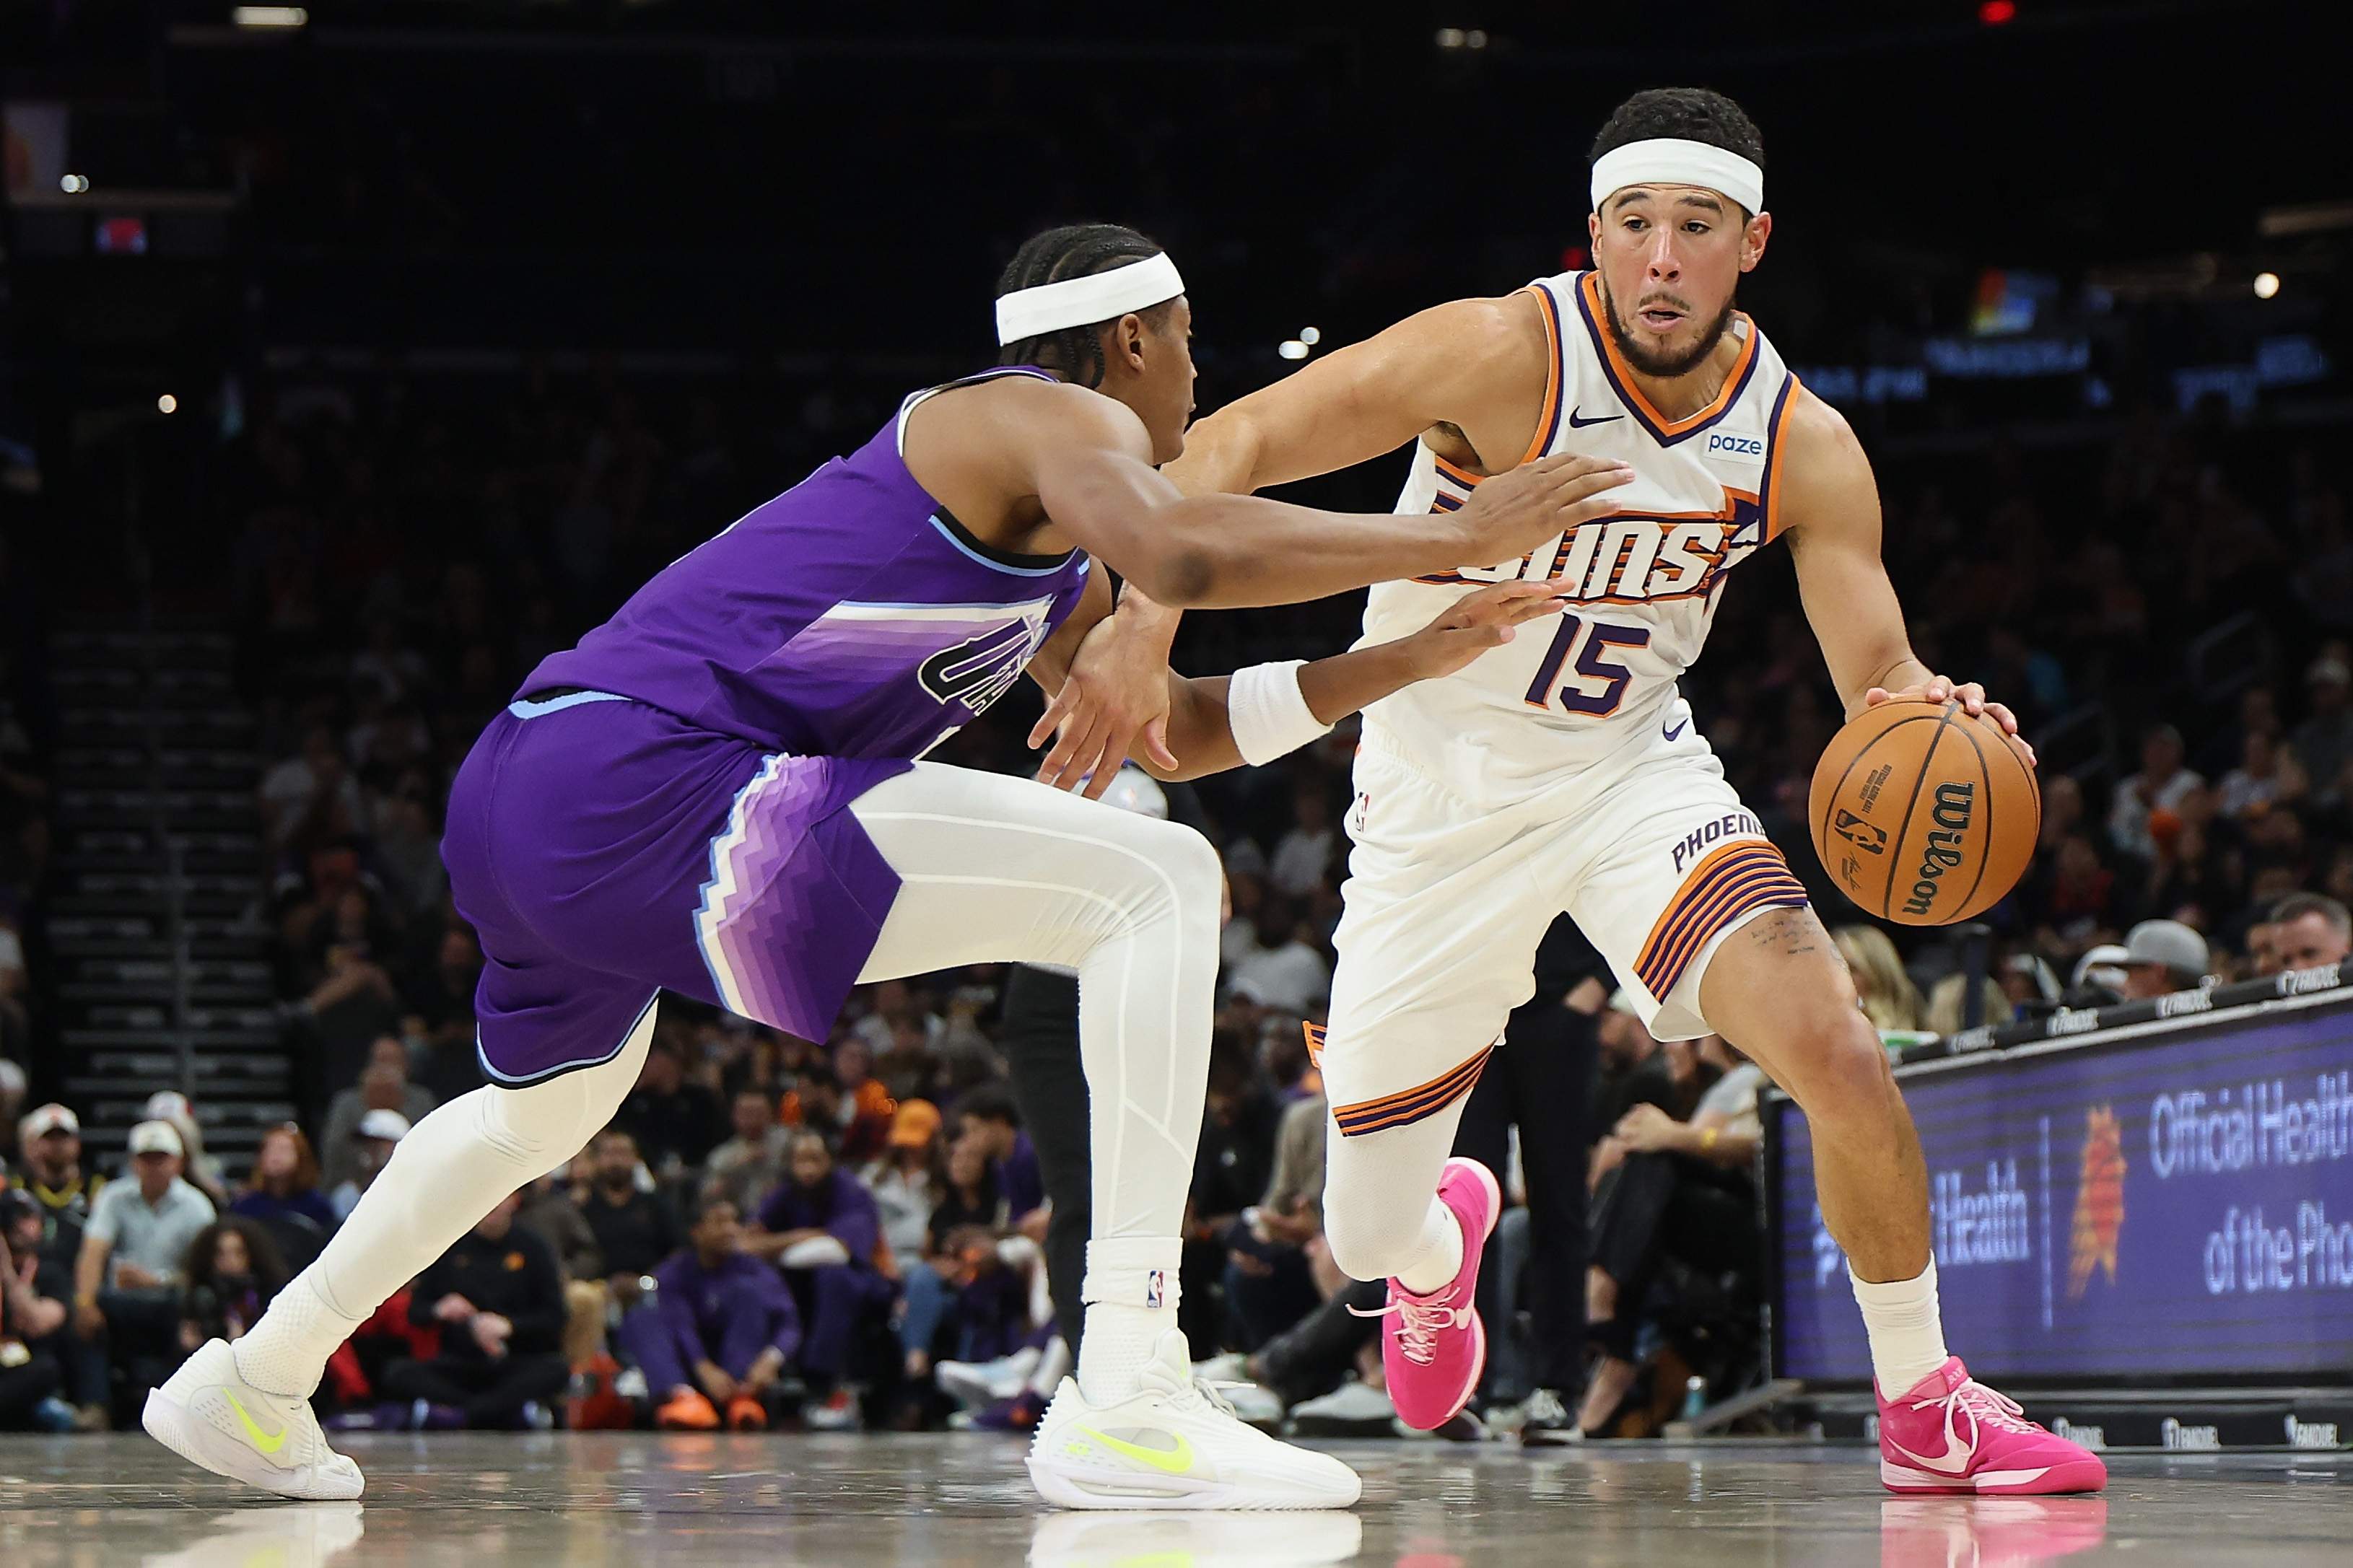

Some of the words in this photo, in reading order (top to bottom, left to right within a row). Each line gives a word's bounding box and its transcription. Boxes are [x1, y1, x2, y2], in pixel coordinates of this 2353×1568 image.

[1708, 434, 1762, 455] paze
[1457, 520, 1724, 598] UNS
[1524, 611, 1651, 719] 15
[1901, 781, 1975, 915] Wilson
[2149, 1084, 2253, 1179] Official
[2204, 1206, 2238, 1295] of
[2240, 1204, 2295, 1293] the
